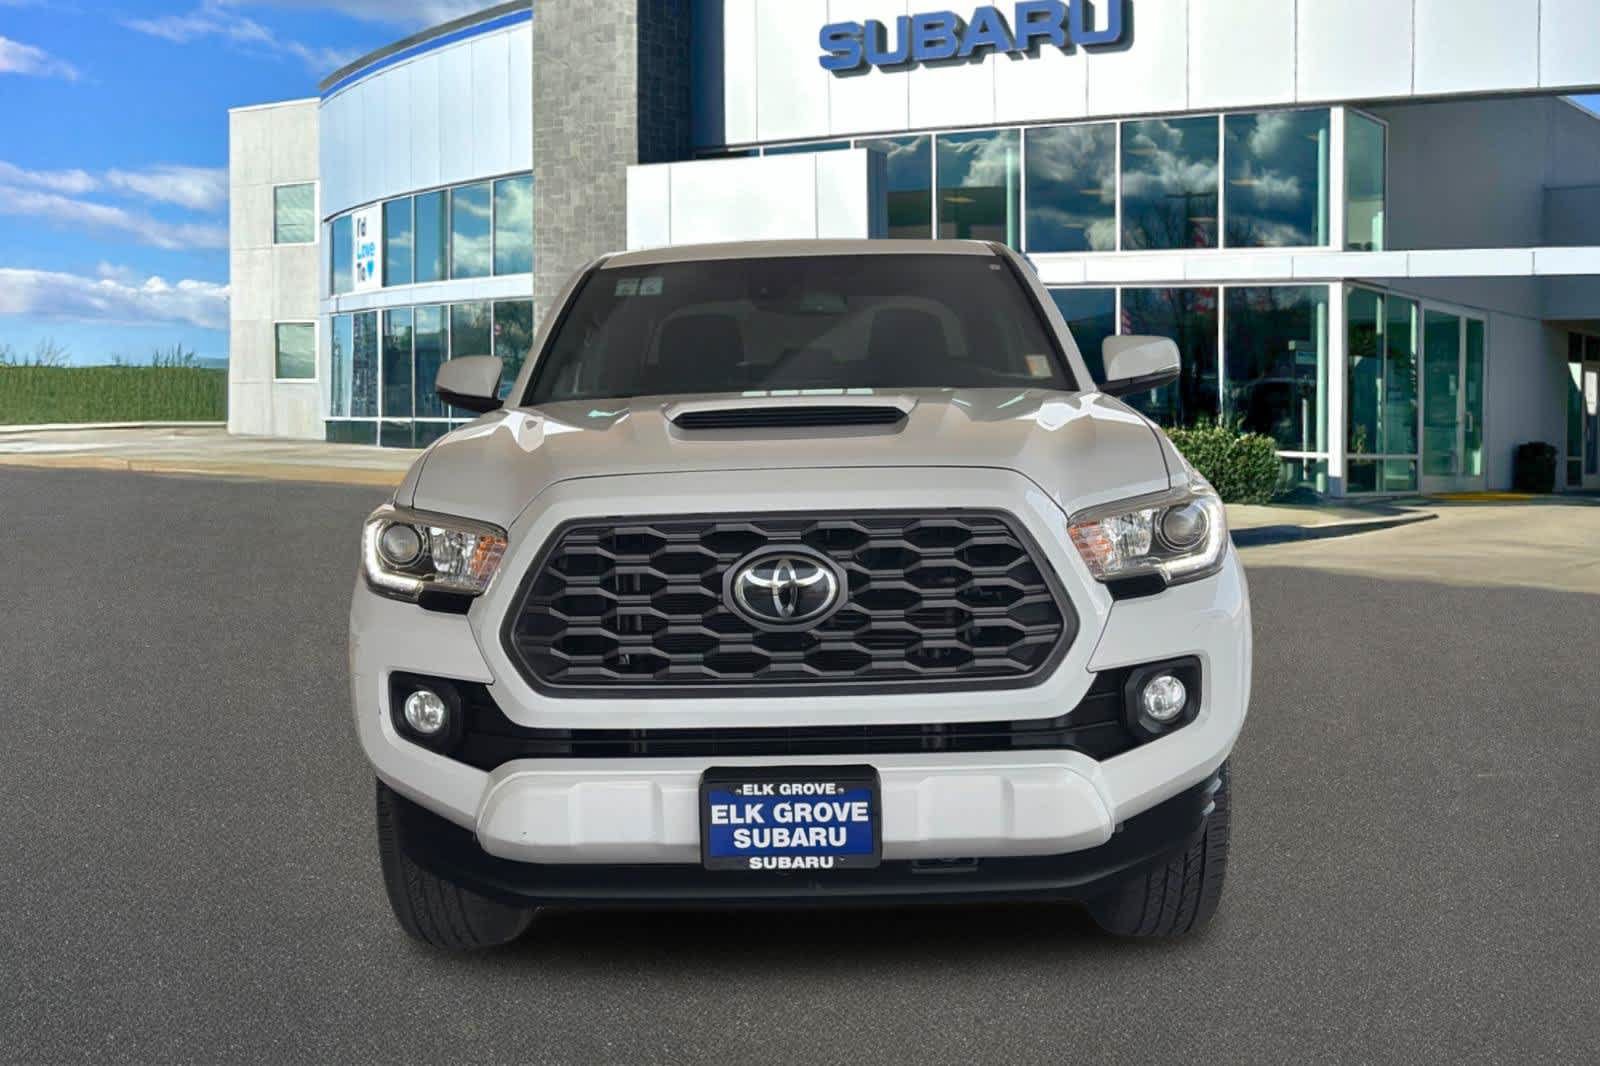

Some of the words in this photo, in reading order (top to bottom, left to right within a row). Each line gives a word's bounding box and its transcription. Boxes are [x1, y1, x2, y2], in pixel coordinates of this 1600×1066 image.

[818, 0, 1134, 78] SUBARU
[743, 784, 774, 796] ELK
[779, 783, 836, 795] GROVE
[711, 804, 765, 825] ELK
[773, 801, 869, 823] GROVE
[733, 827, 847, 849] SUBARU
[749, 856, 834, 869] SUBARU
